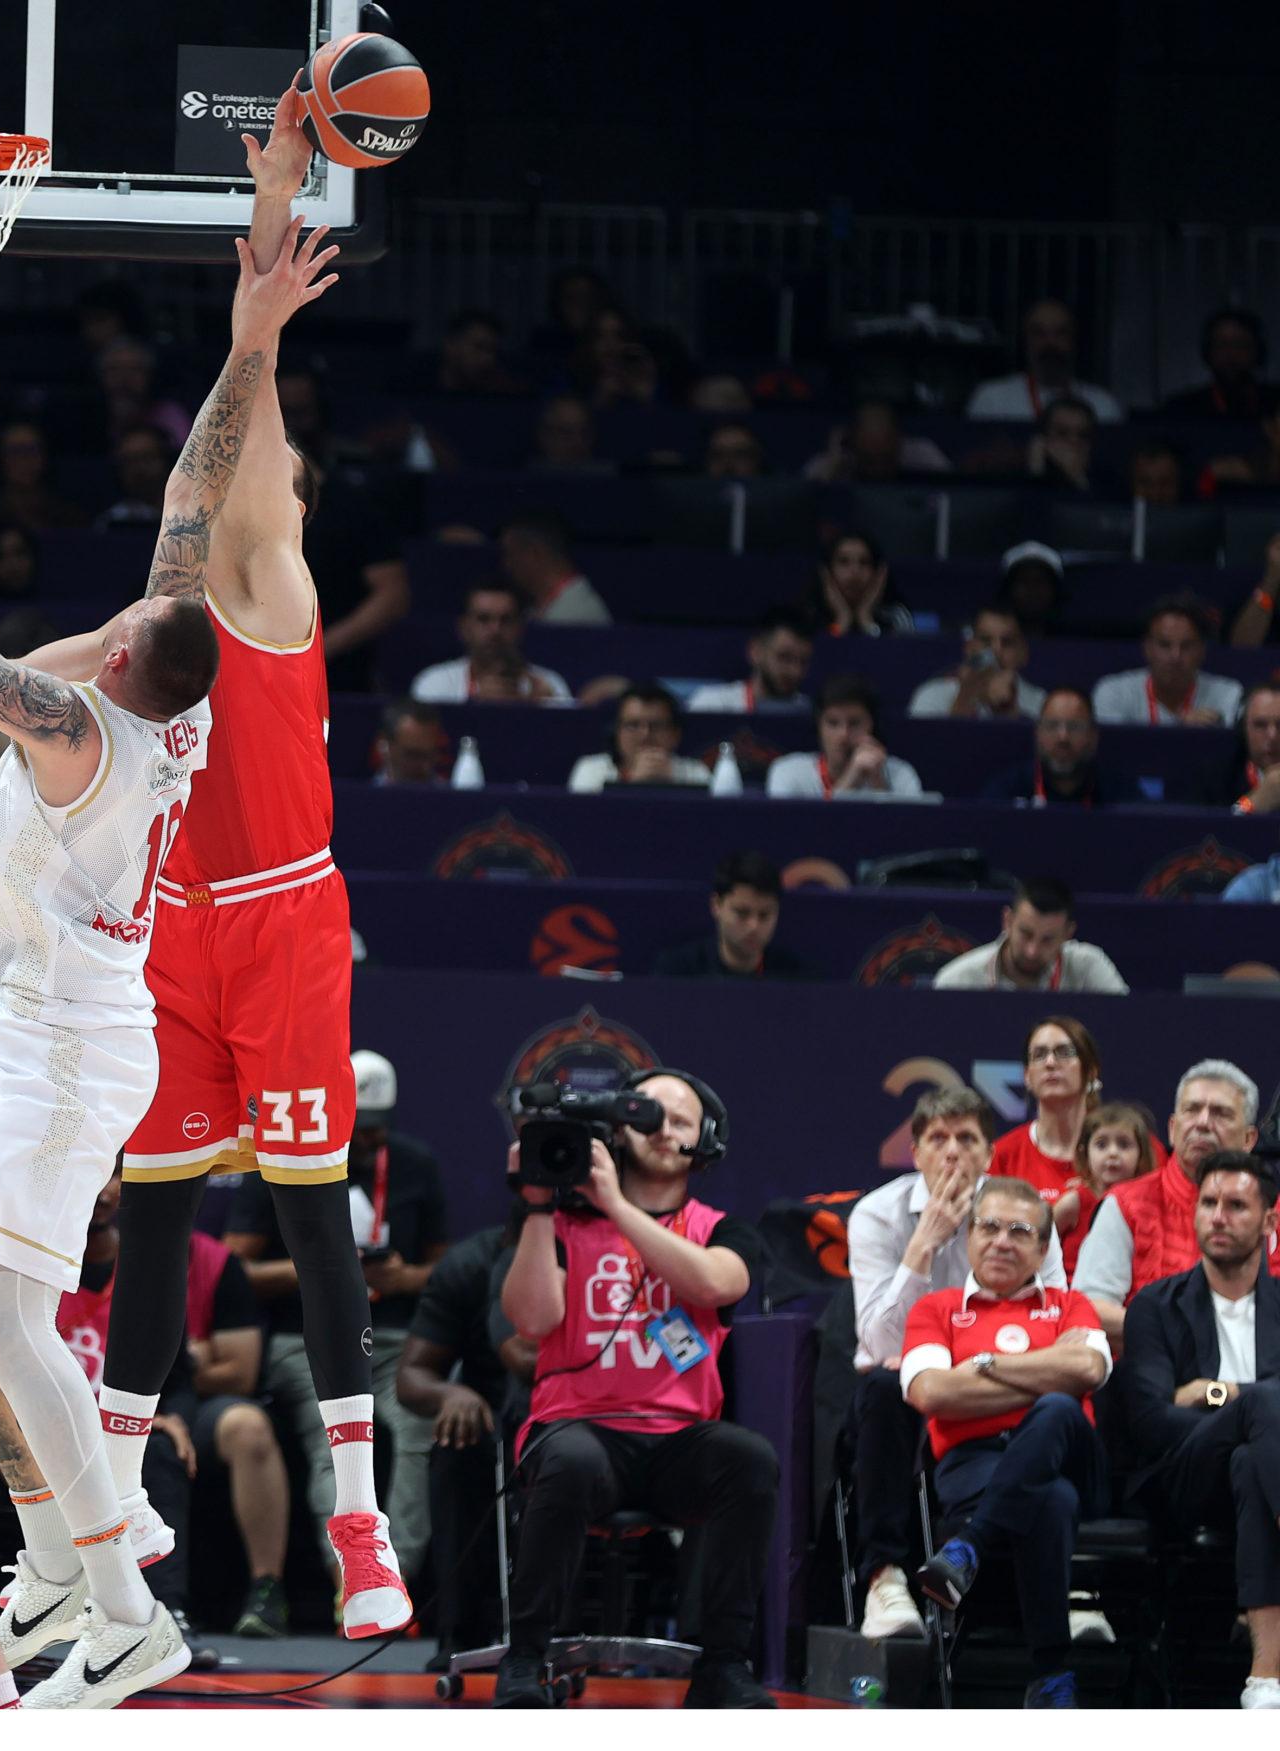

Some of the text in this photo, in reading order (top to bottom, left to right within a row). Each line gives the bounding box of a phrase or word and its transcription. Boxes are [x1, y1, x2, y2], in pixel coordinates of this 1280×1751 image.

[211, 103, 276, 120] onetea
[238, 122, 268, 130] TURKISH
[261, 1086, 330, 1145] 33
[586, 1331, 663, 1369] TV
